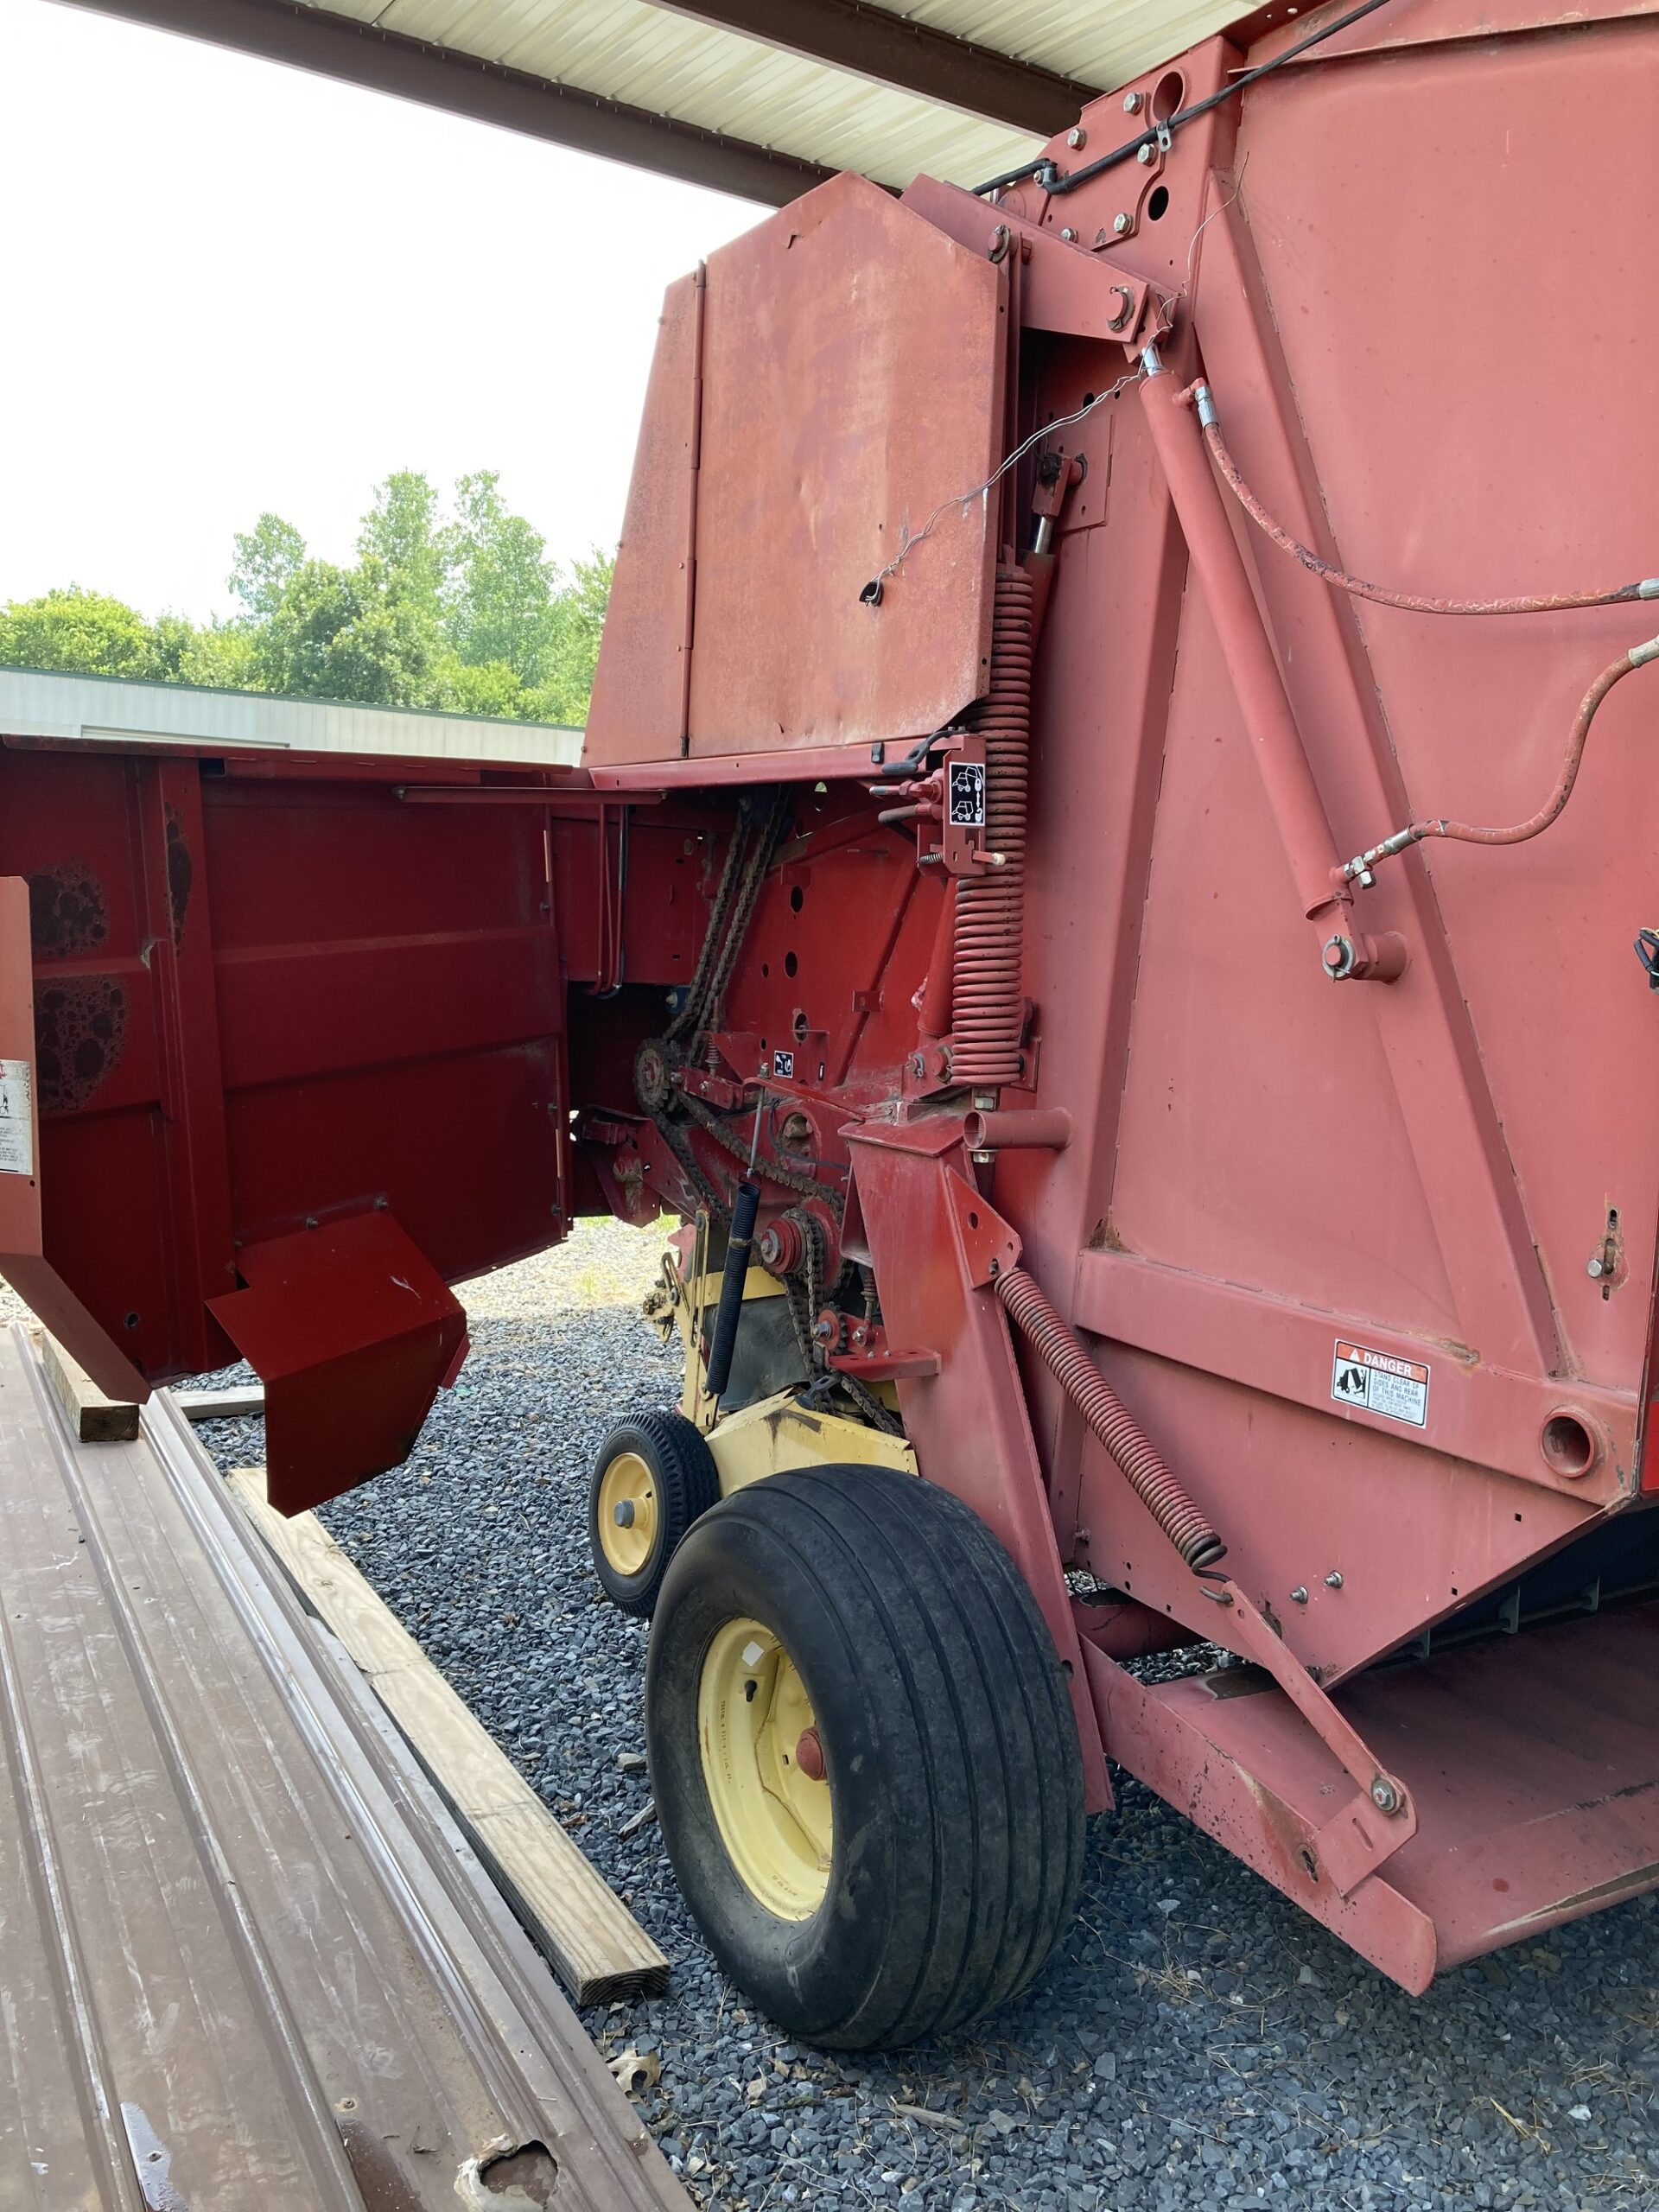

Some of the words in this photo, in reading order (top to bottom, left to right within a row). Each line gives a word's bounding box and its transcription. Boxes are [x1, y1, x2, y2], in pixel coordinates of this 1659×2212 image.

[1363, 1352, 1411, 1376] DANGER
[1374, 1371, 1391, 1381] STAND
[1393, 1377, 1410, 1386] CLEAR
[1374, 1378, 1389, 1388] SIDES
[1404, 1387, 1418, 1397] REAR
[1382, 1388, 1394, 1397] THIS
[1396, 1392, 1421, 1406] MACHINE
